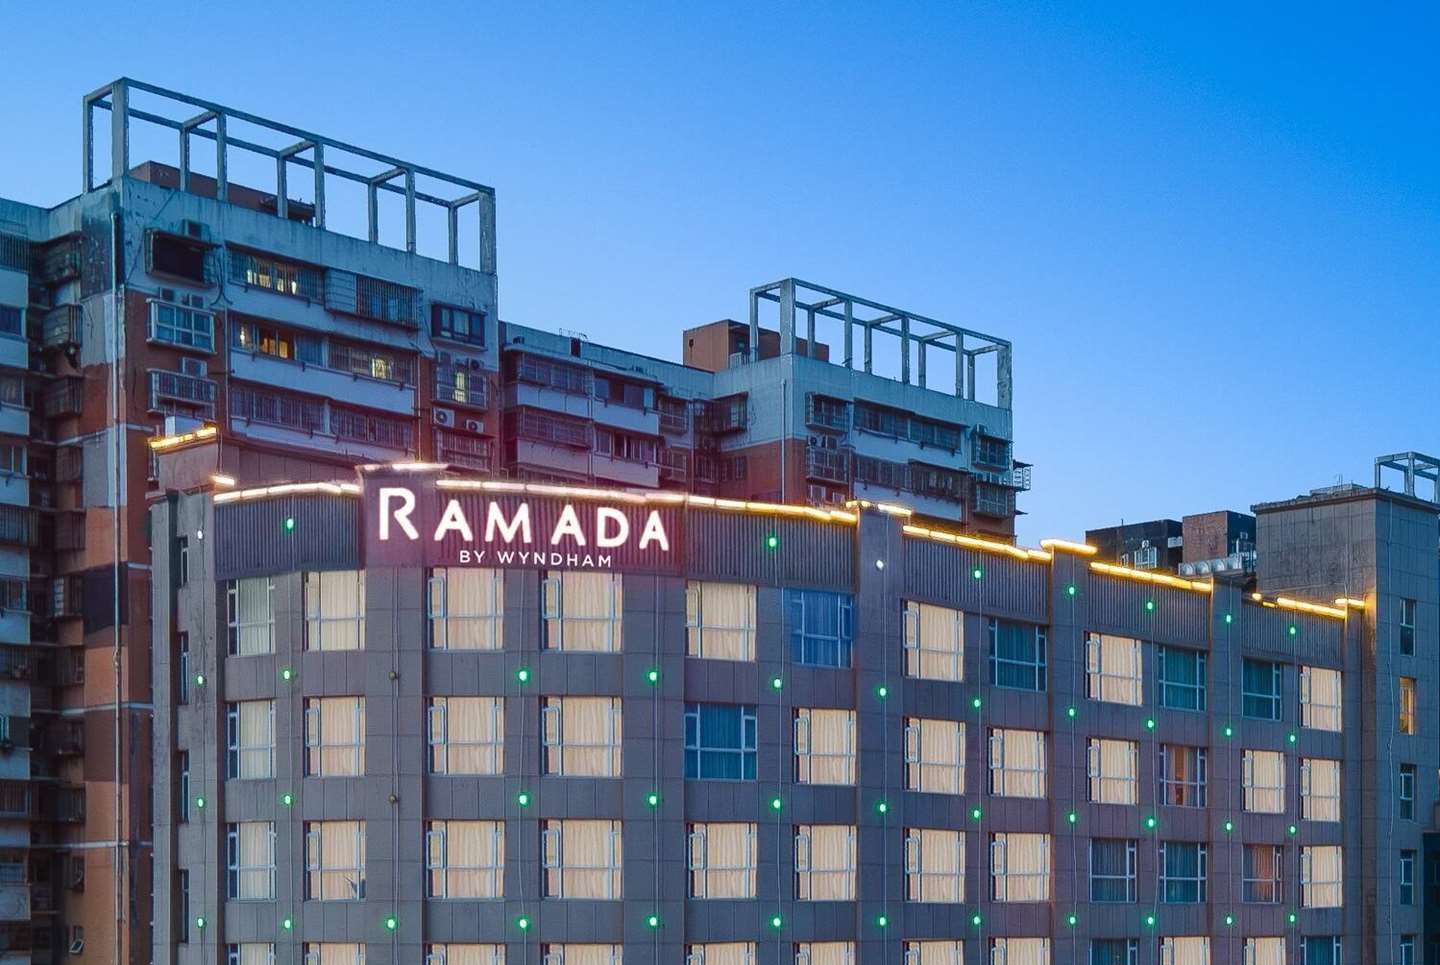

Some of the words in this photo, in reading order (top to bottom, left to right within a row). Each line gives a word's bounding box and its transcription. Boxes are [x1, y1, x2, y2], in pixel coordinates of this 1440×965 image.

[378, 487, 671, 552] RAMADA
[459, 549, 486, 564] BY
[498, 550, 613, 569] WYNDHAM
